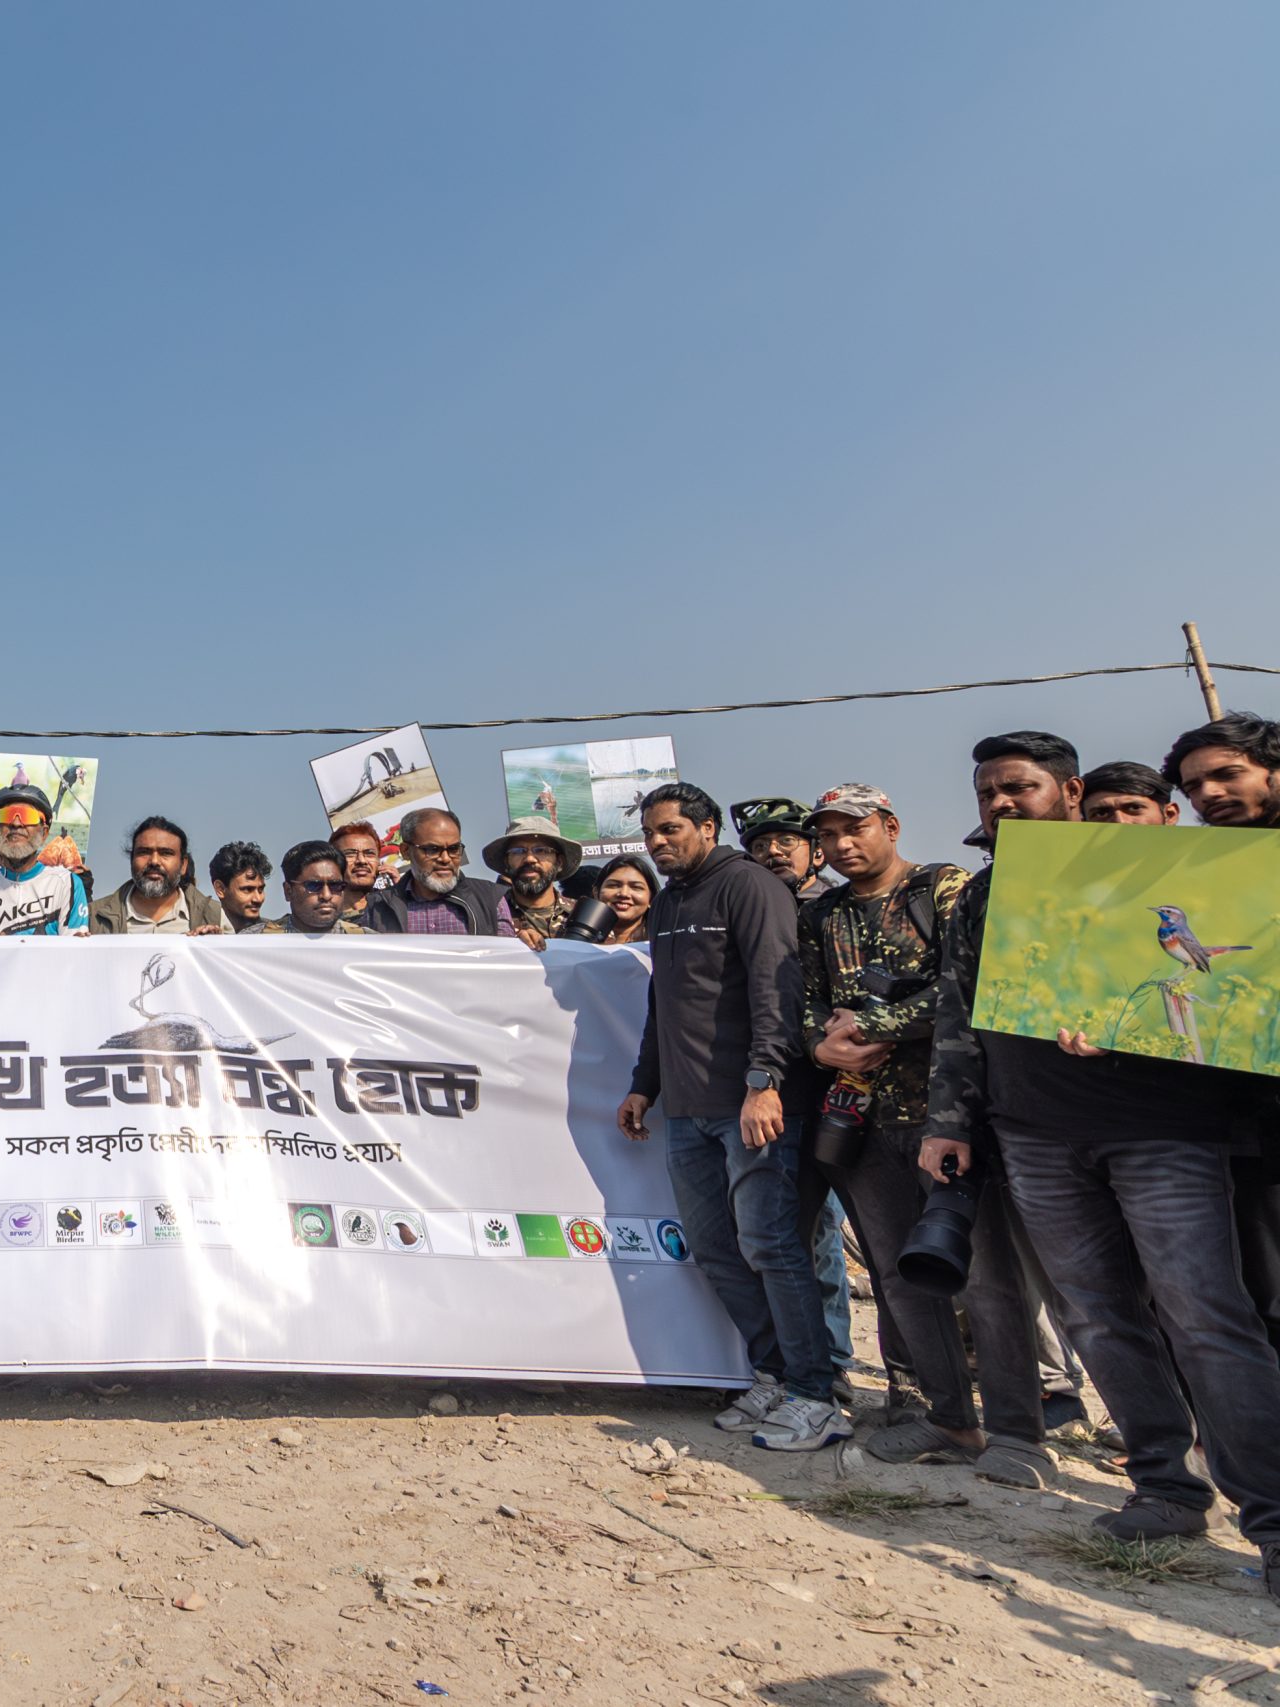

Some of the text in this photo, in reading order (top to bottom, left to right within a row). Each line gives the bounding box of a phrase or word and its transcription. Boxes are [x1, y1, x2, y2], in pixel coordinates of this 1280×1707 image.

[59, 1053, 204, 1108] হত্যা
[217, 1054, 318, 1118] বন্ধ
[326, 1057, 483, 1119] হোক
[5, 1136, 70, 1156] সকল
[75, 1126, 144, 1162] প্রকৃতি
